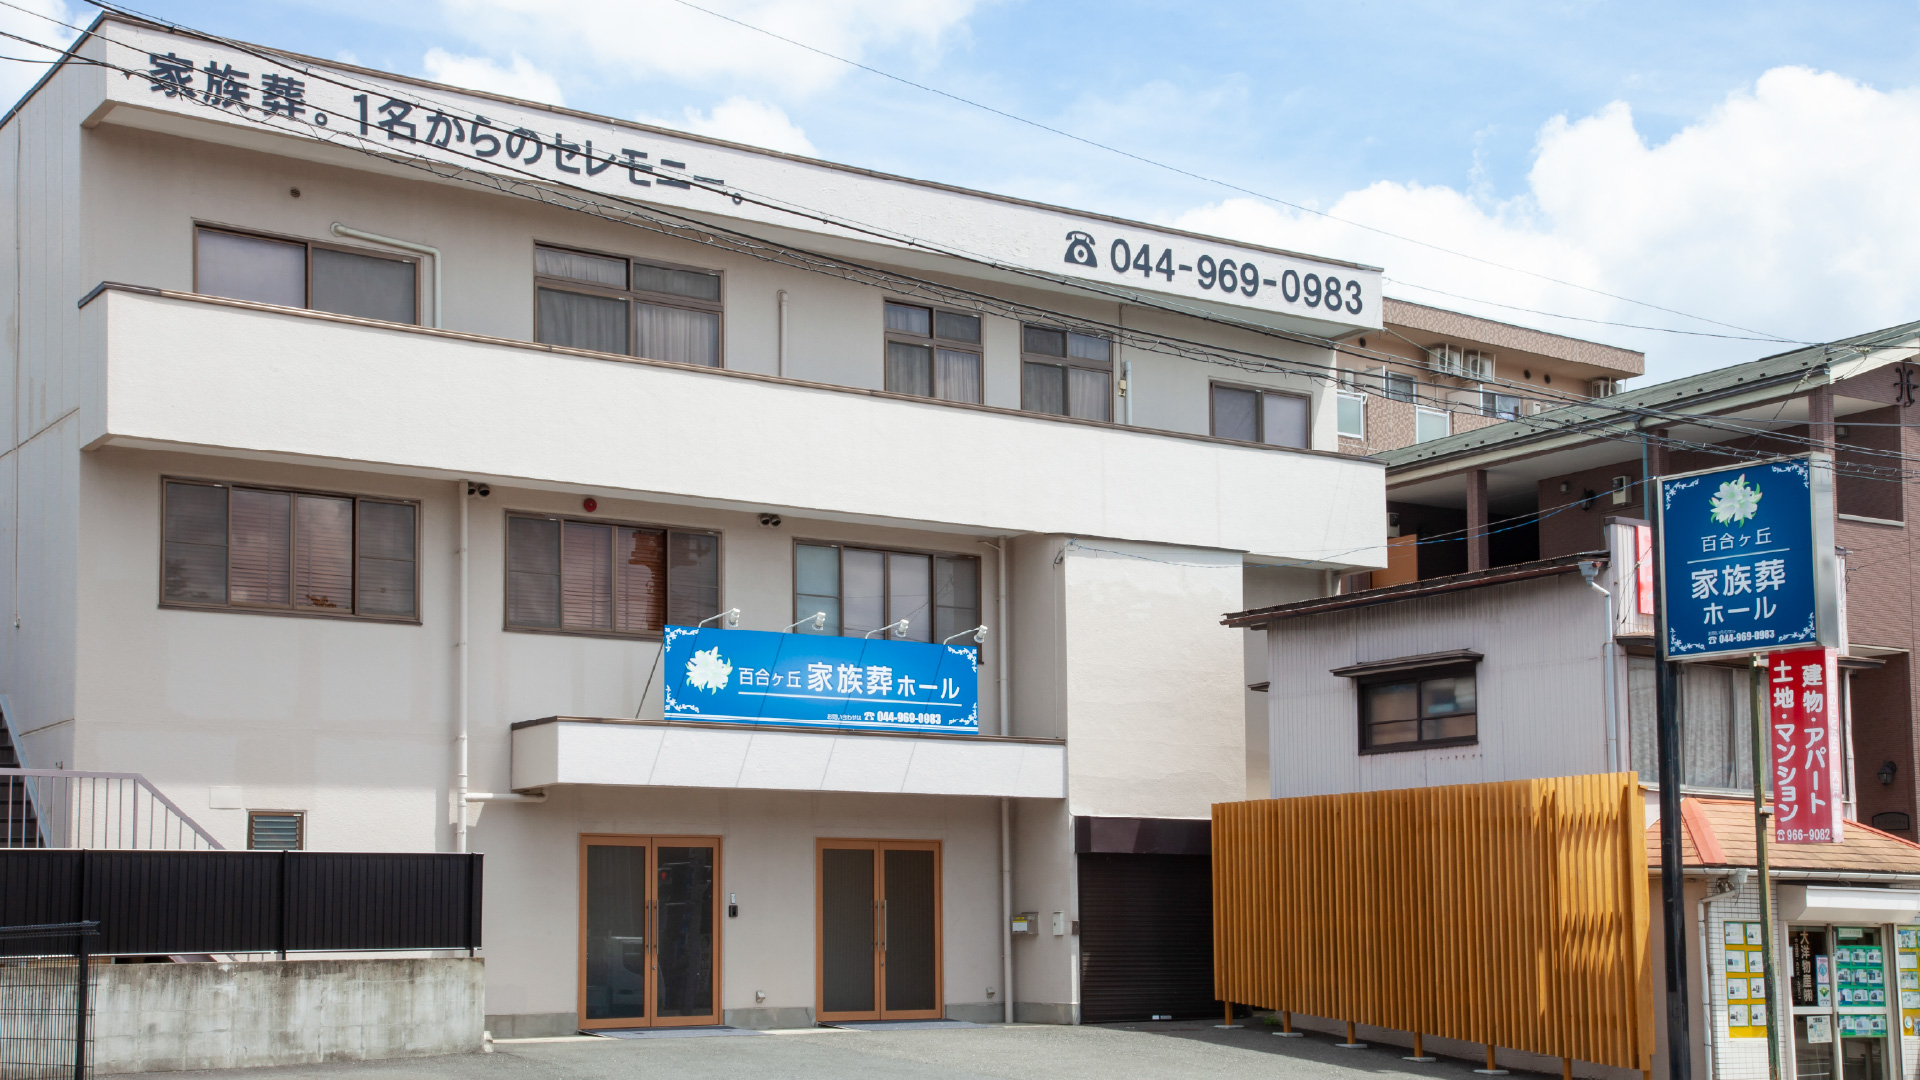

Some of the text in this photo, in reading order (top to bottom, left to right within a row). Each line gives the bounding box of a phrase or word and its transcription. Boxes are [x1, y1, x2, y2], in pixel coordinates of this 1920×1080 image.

[149, 51, 742, 206] 家族葬。1名からのセレモニー。
[1110, 238, 1363, 315] 044-969-0983
[1701, 527, 1772, 552] 百合ヶ丘
[1691, 558, 1786, 599] 家族葬
[1703, 596, 1777, 625] ホール
[1719, 630, 1775, 644] 044-969-0983
[877, 711, 941, 725] 044-969-0983
[1773, 660, 1798, 822] 土地・マンション
[1802, 664, 1826, 814] 建物・アパート
[1787, 828, 1830, 841] 966-9082
